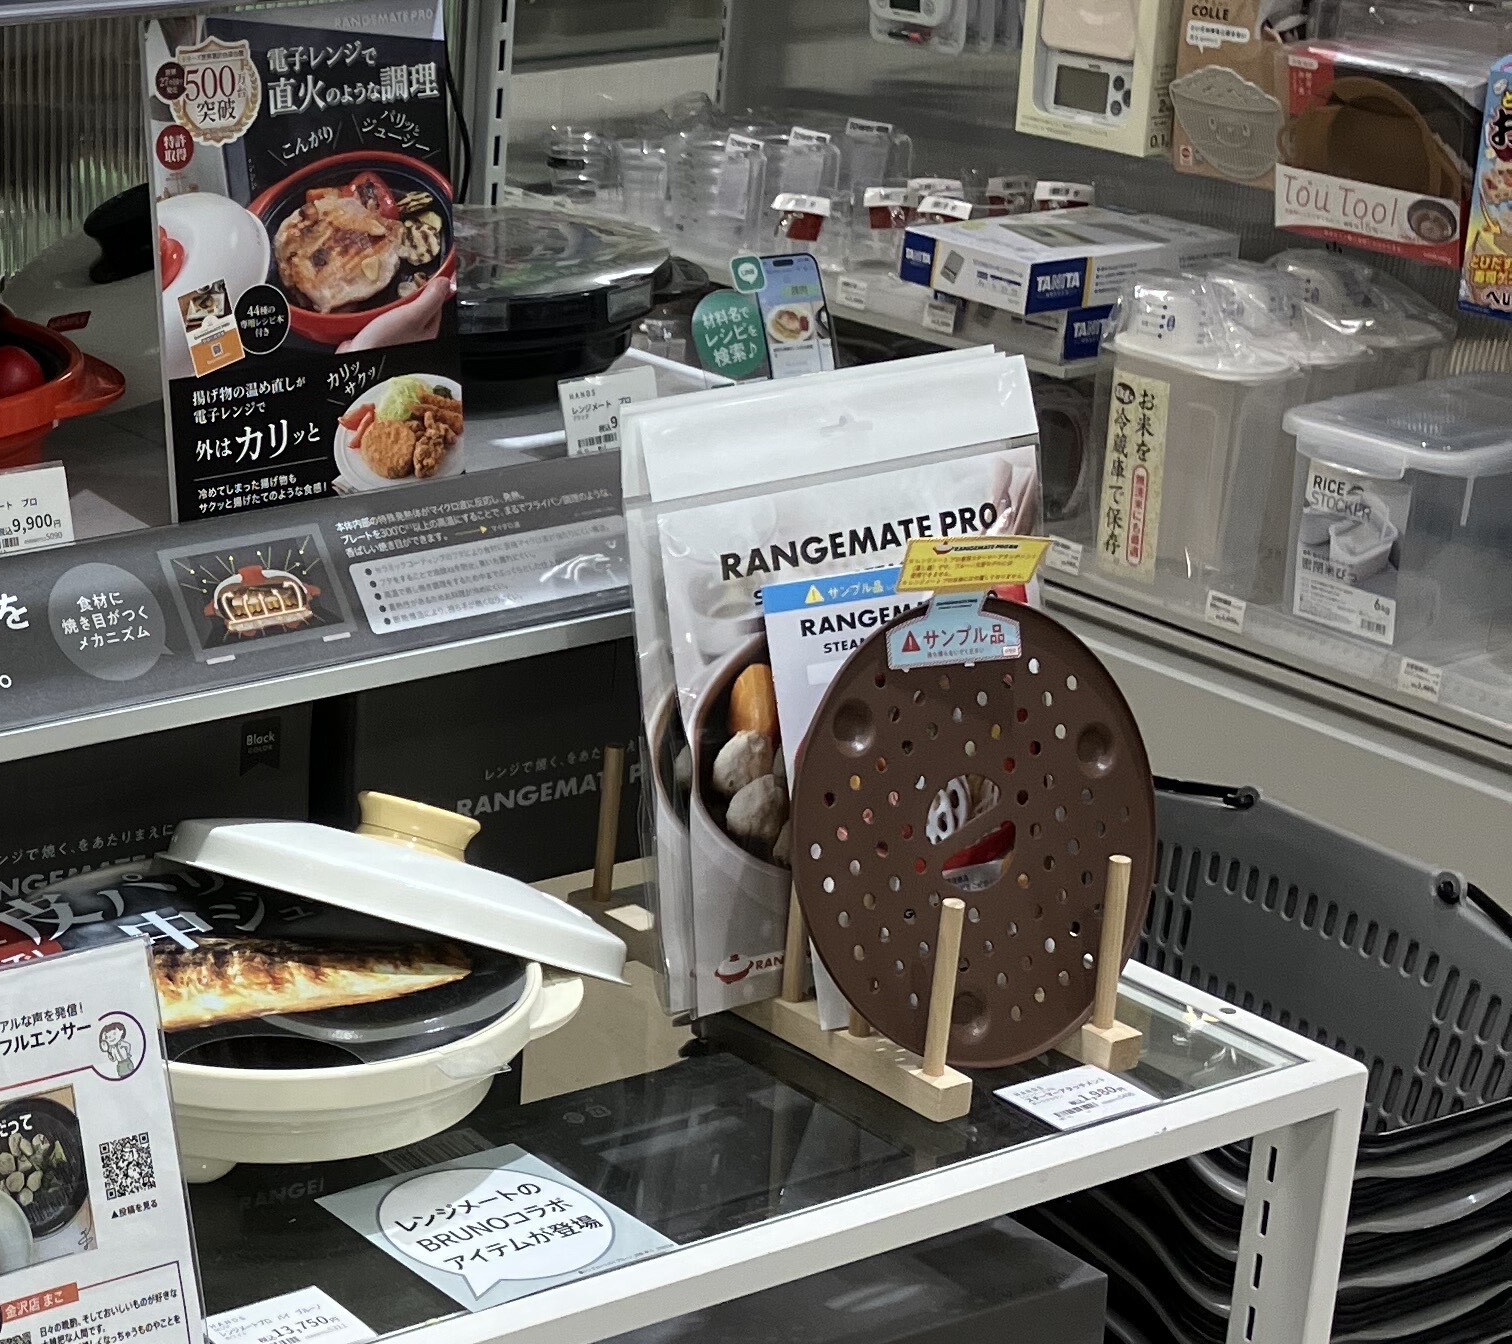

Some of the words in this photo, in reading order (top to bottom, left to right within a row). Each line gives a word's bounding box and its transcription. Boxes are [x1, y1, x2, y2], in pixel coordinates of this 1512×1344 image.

[1191, 4, 1230, 22] COLLE
[266, 40, 378, 74] 電子レンジで
[266, 61, 440, 118] 直火のような調理
[196, 98, 237, 124] 突破
[282, 125, 334, 161] こんがり
[1037, 271, 1081, 294] TANITA
[701, 306, 751, 330] 材料名で
[704, 322, 758, 348] レシピを
[192, 376, 307, 406] 揚げ物の温め直しが
[193, 401, 266, 425] 電子レンジで
[571, 399, 613, 416] レンジメート
[1135, 388, 1156, 462] お米を
[195, 419, 322, 463] 外はカリッと
[197, 474, 297, 501] 冷めてしまった揚げ物も
[1104, 406, 1131, 556] 冷蔵庫で保存
[1313, 474, 1346, 497] RICE
[20, 497, 39, 508] プロ
[720, 515, 934, 582] RANGEMATE
[939, 502, 999, 538] PRO
[76, 591, 125, 613] 食材に
[827, 579, 885, 599] サンプル品
[61, 605, 150, 636] 焼き目がつく
[79, 625, 152, 652] メカニズム
[923, 624, 1006, 651] サンプル品
[246, 730, 276, 746] Black
[394, 1179, 543, 1234] レンジメートの
[415, 1196, 574, 1254] BRUNOコラボ
[441, 1213, 605, 1273] アイテムが登場
[4, 1296, 40, 1319] 金沢店
[42, 1290, 65, 1307] まこ
